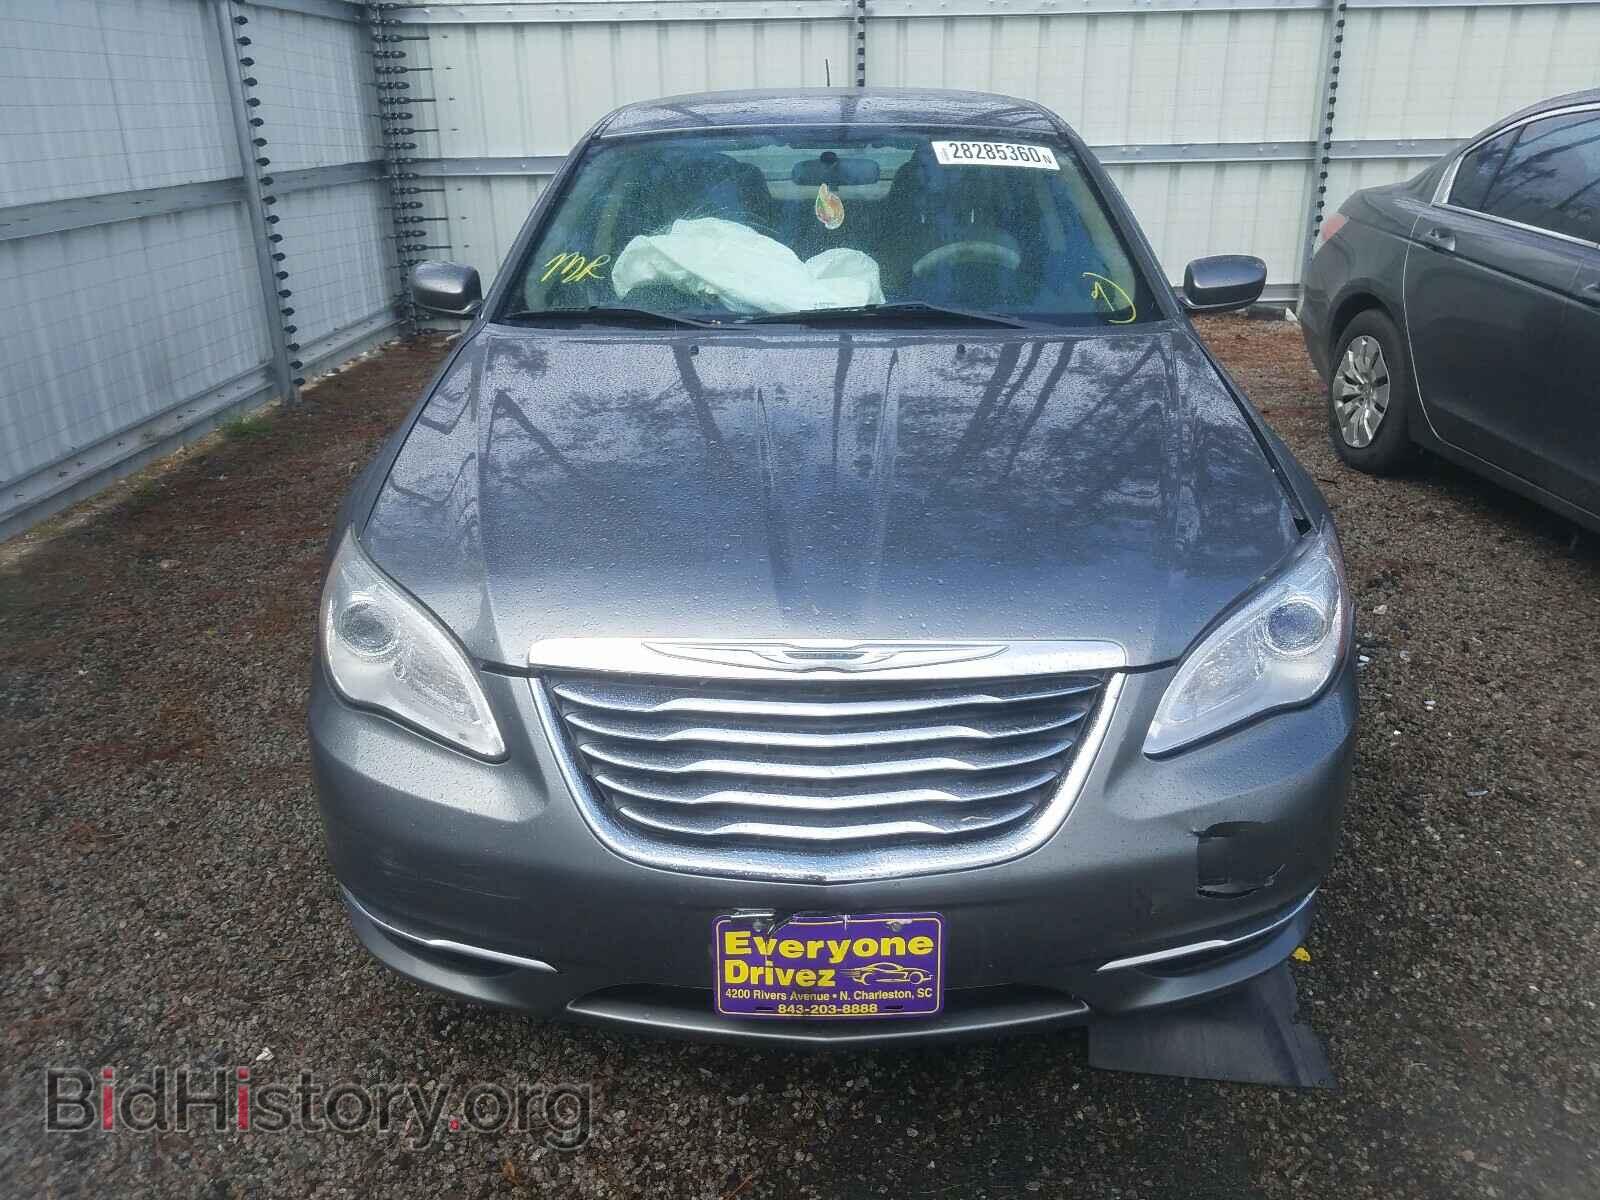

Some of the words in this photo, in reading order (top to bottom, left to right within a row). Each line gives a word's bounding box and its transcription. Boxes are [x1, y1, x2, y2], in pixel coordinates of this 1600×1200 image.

[949, 143, 1041, 163] 28285360
[724, 932, 935, 963] Everyone
[724, 960, 836, 987] Drivez
[725, 989, 750, 999] 4200
[753, 990, 787, 1001] Rivers
[789, 991, 830, 1001] Avenue
[839, 991, 851, 1001] N.
[853, 989, 915, 1000] Charleston,
[917, 988, 933, 998] SC
[777, 1004, 878, 1014] 843-203-8888
